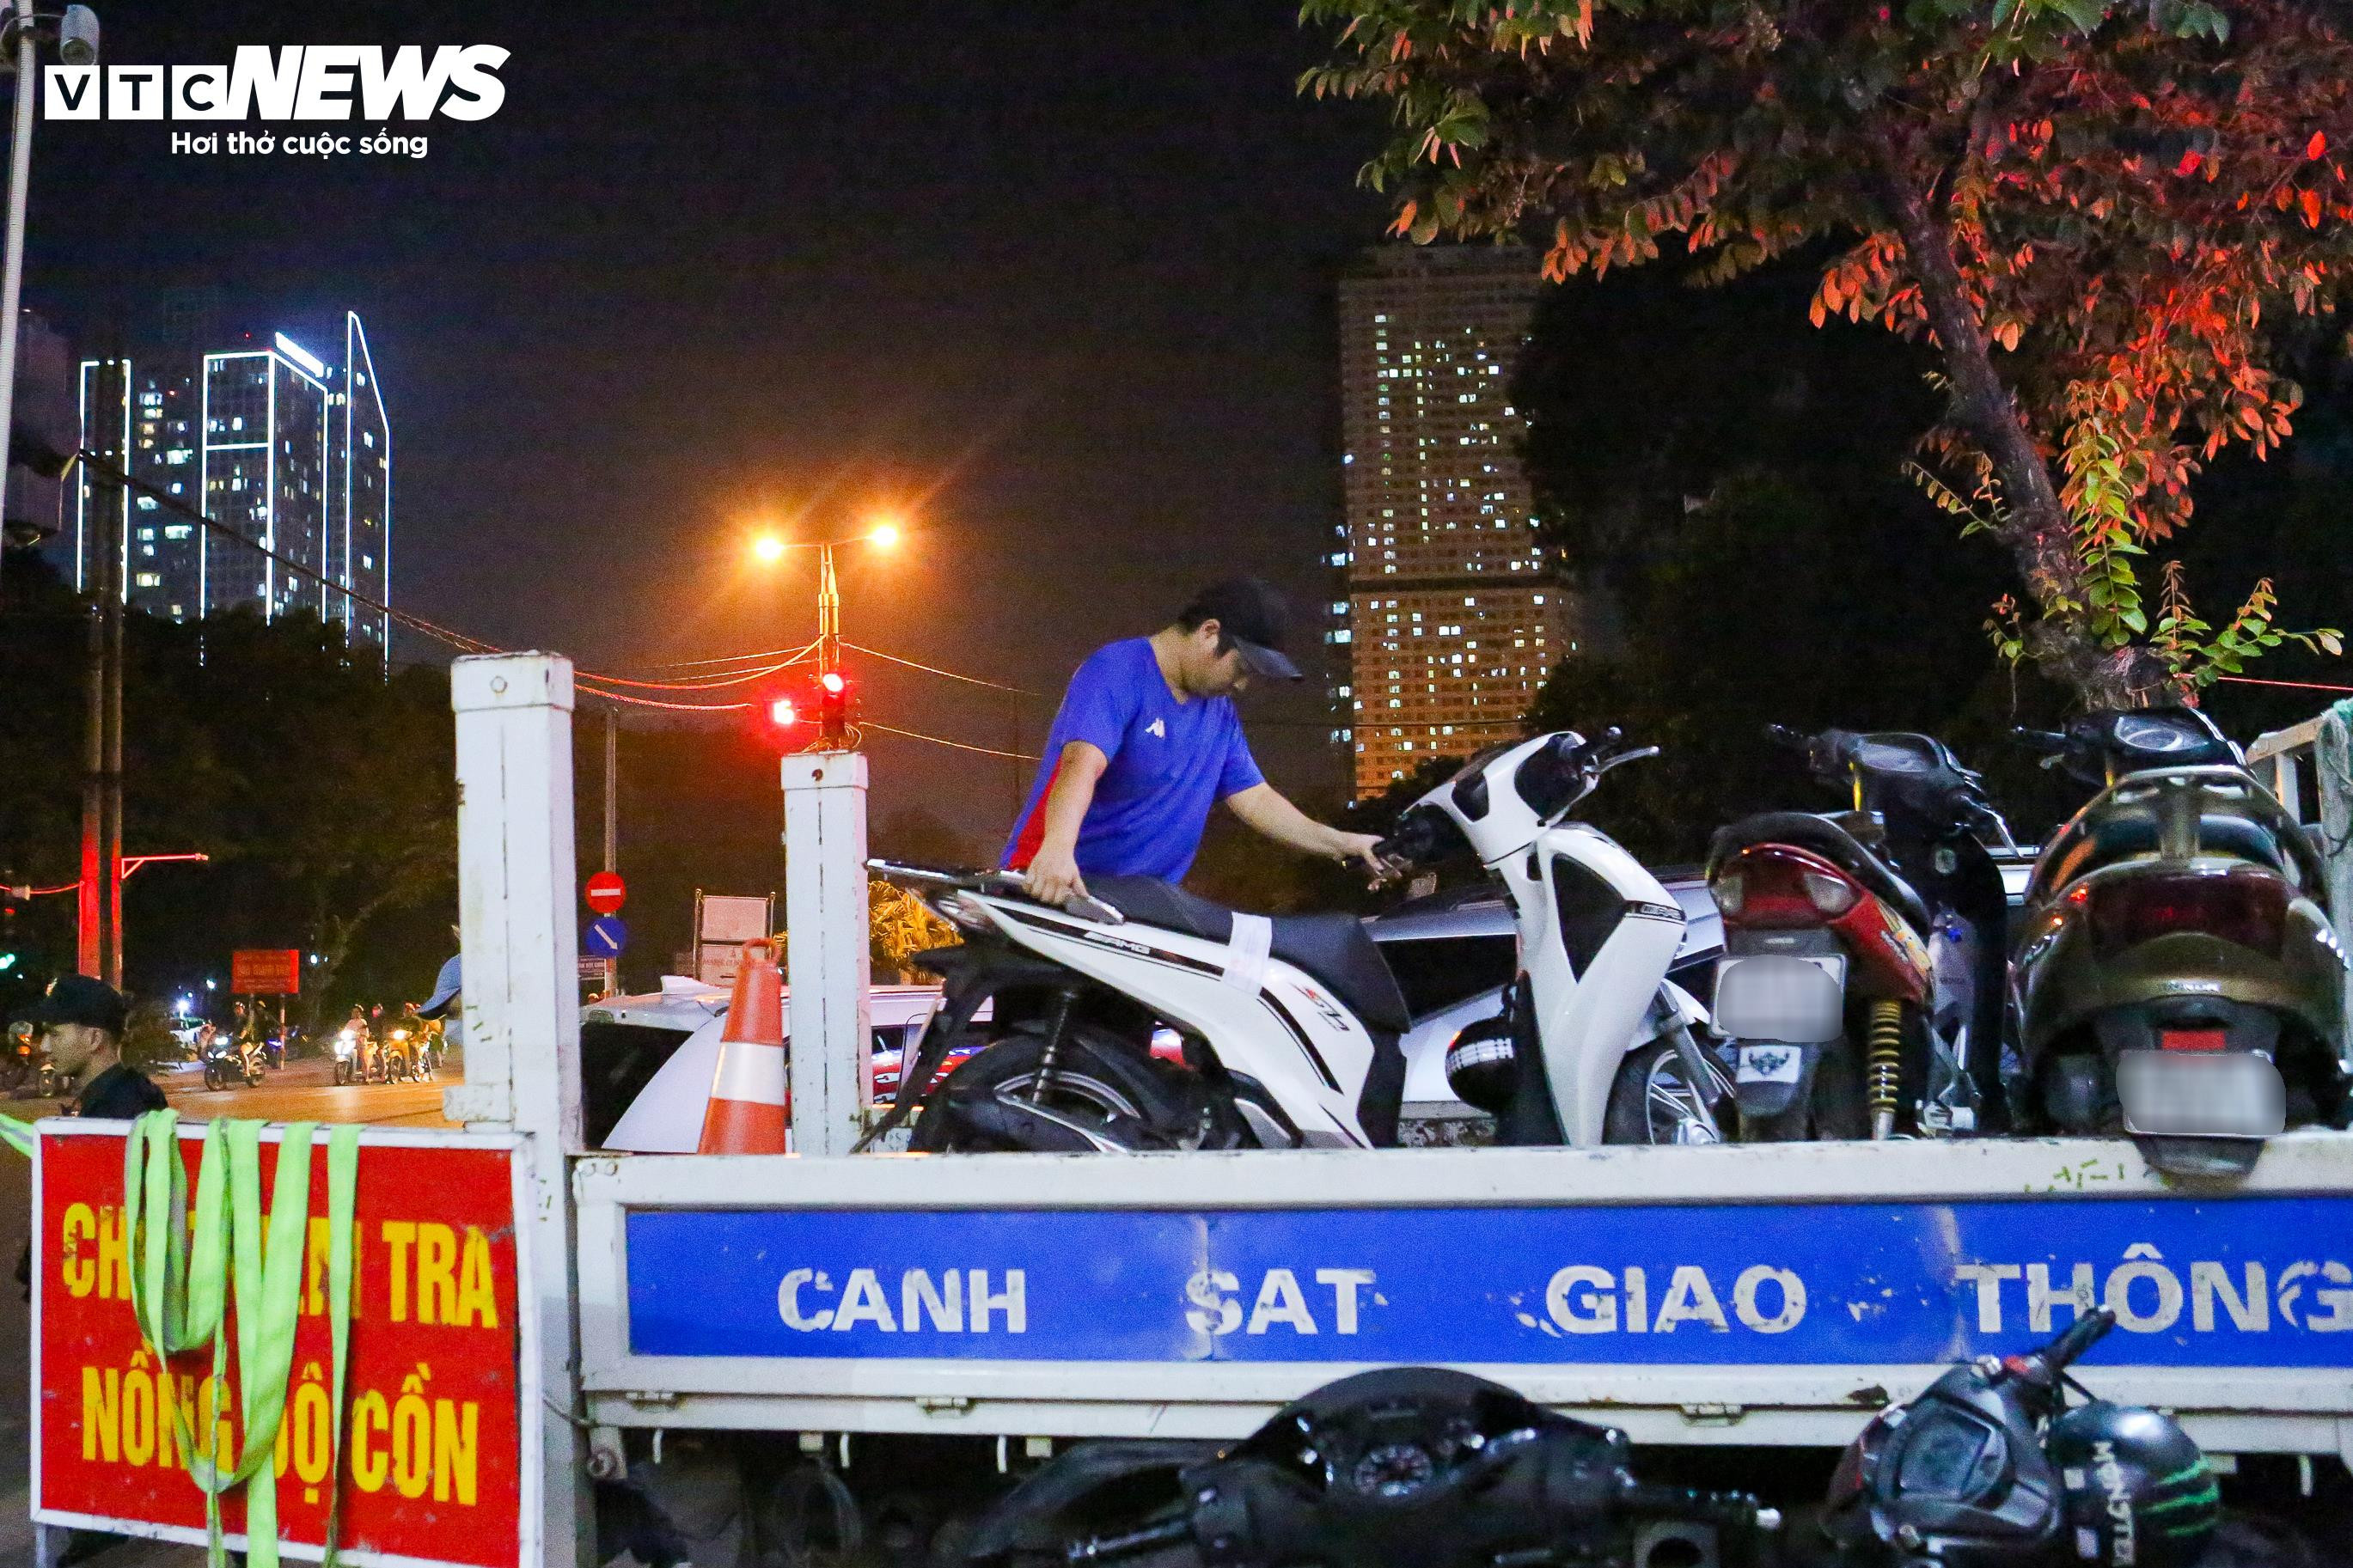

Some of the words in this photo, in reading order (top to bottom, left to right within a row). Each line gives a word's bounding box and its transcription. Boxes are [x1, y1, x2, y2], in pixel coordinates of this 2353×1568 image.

[382, 1220, 498, 1331] TRA
[1544, 1264, 1808, 1334] GIAO
[1955, 1242, 2353, 1335] THÔNG
[83, 1336, 234, 1473] NỒNG
[351, 1362, 478, 1507] CỒN
